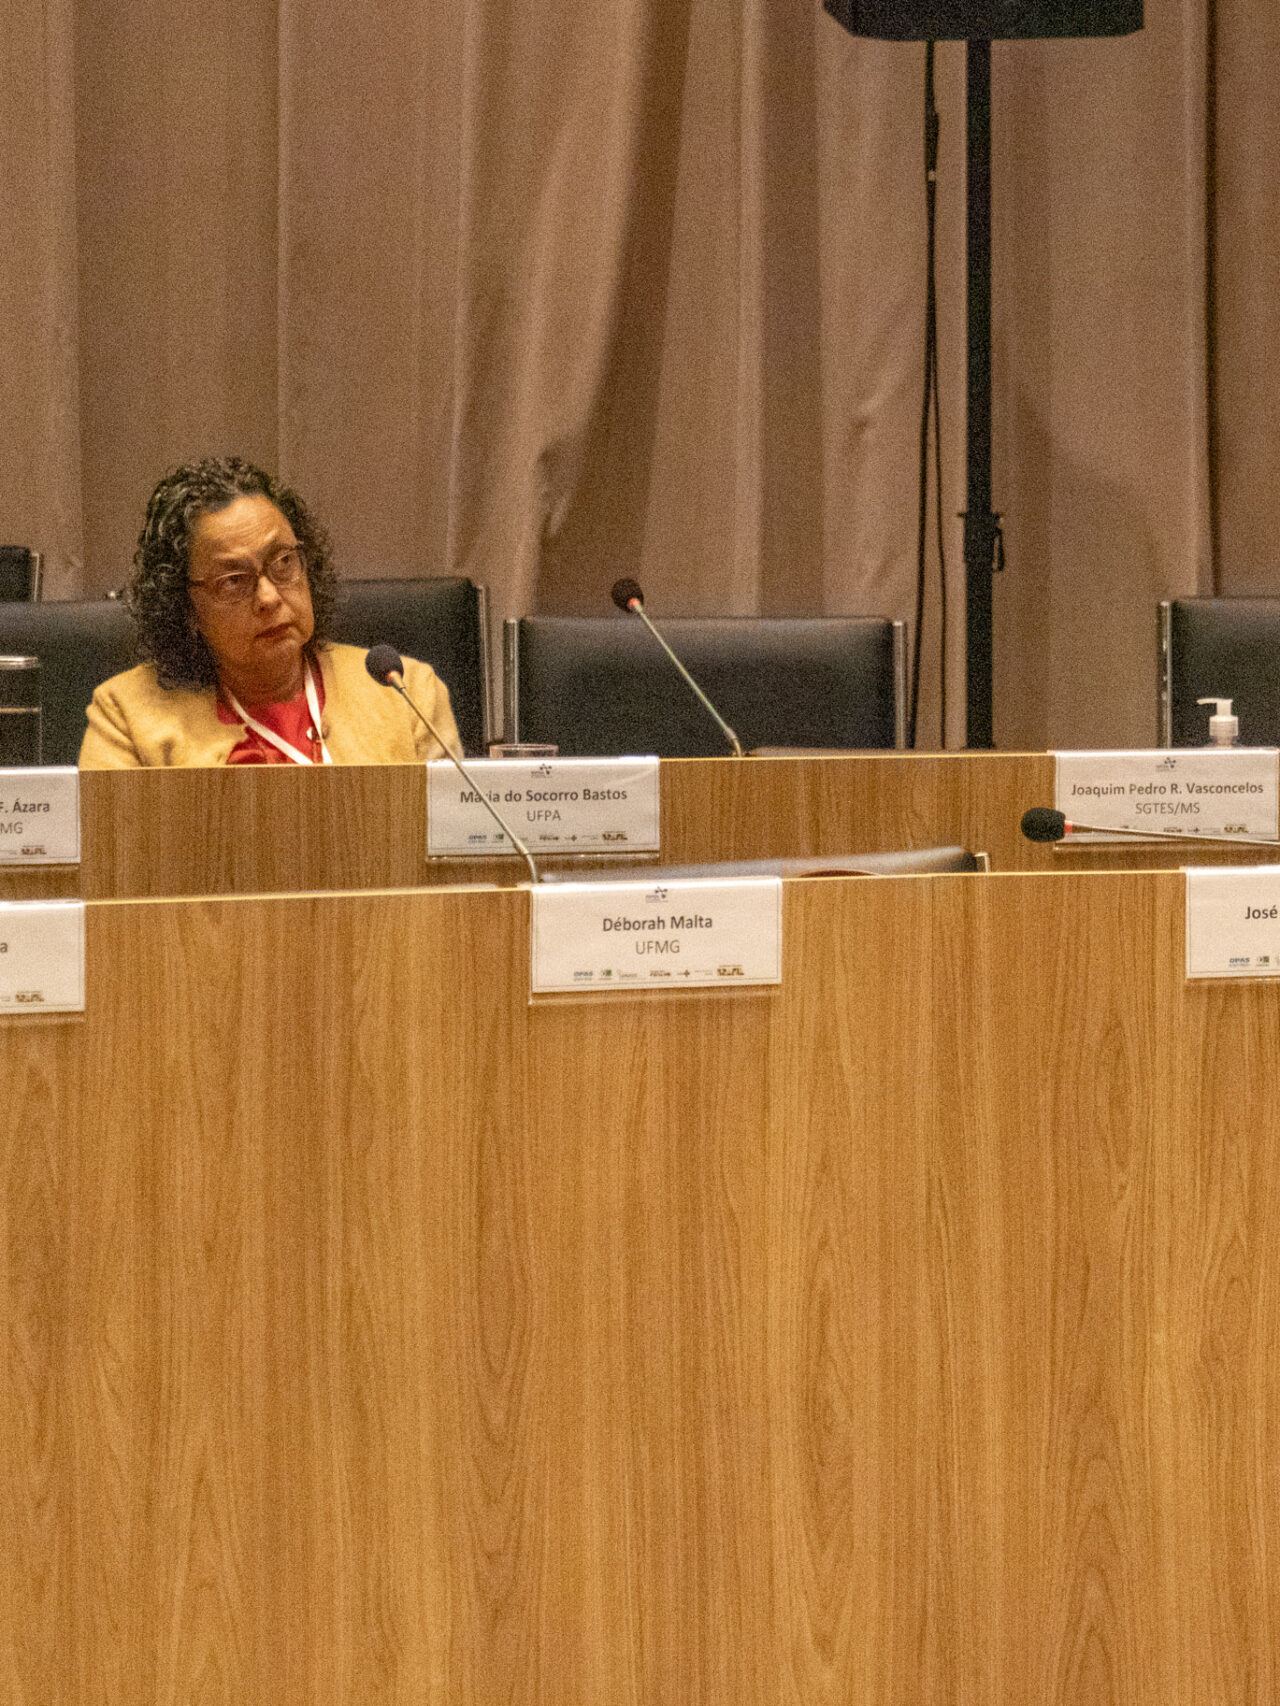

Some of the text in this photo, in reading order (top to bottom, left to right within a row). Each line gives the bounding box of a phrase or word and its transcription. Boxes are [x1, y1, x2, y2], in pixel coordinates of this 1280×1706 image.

[460, 788, 627, 804] Maia do Socorro Bastos
[1071, 781, 1264, 797] Joaquim Pedro R. Vasconcelos
[12, 798, 50, 813] Ázara
[1135, 802, 1200, 815] SGTES/MS
[527, 809, 561, 822] UFPA
[1245, 905, 1279, 920] José
[602, 914, 713, 933] Déborah Malta
[635, 940, 681, 955] UFMG
